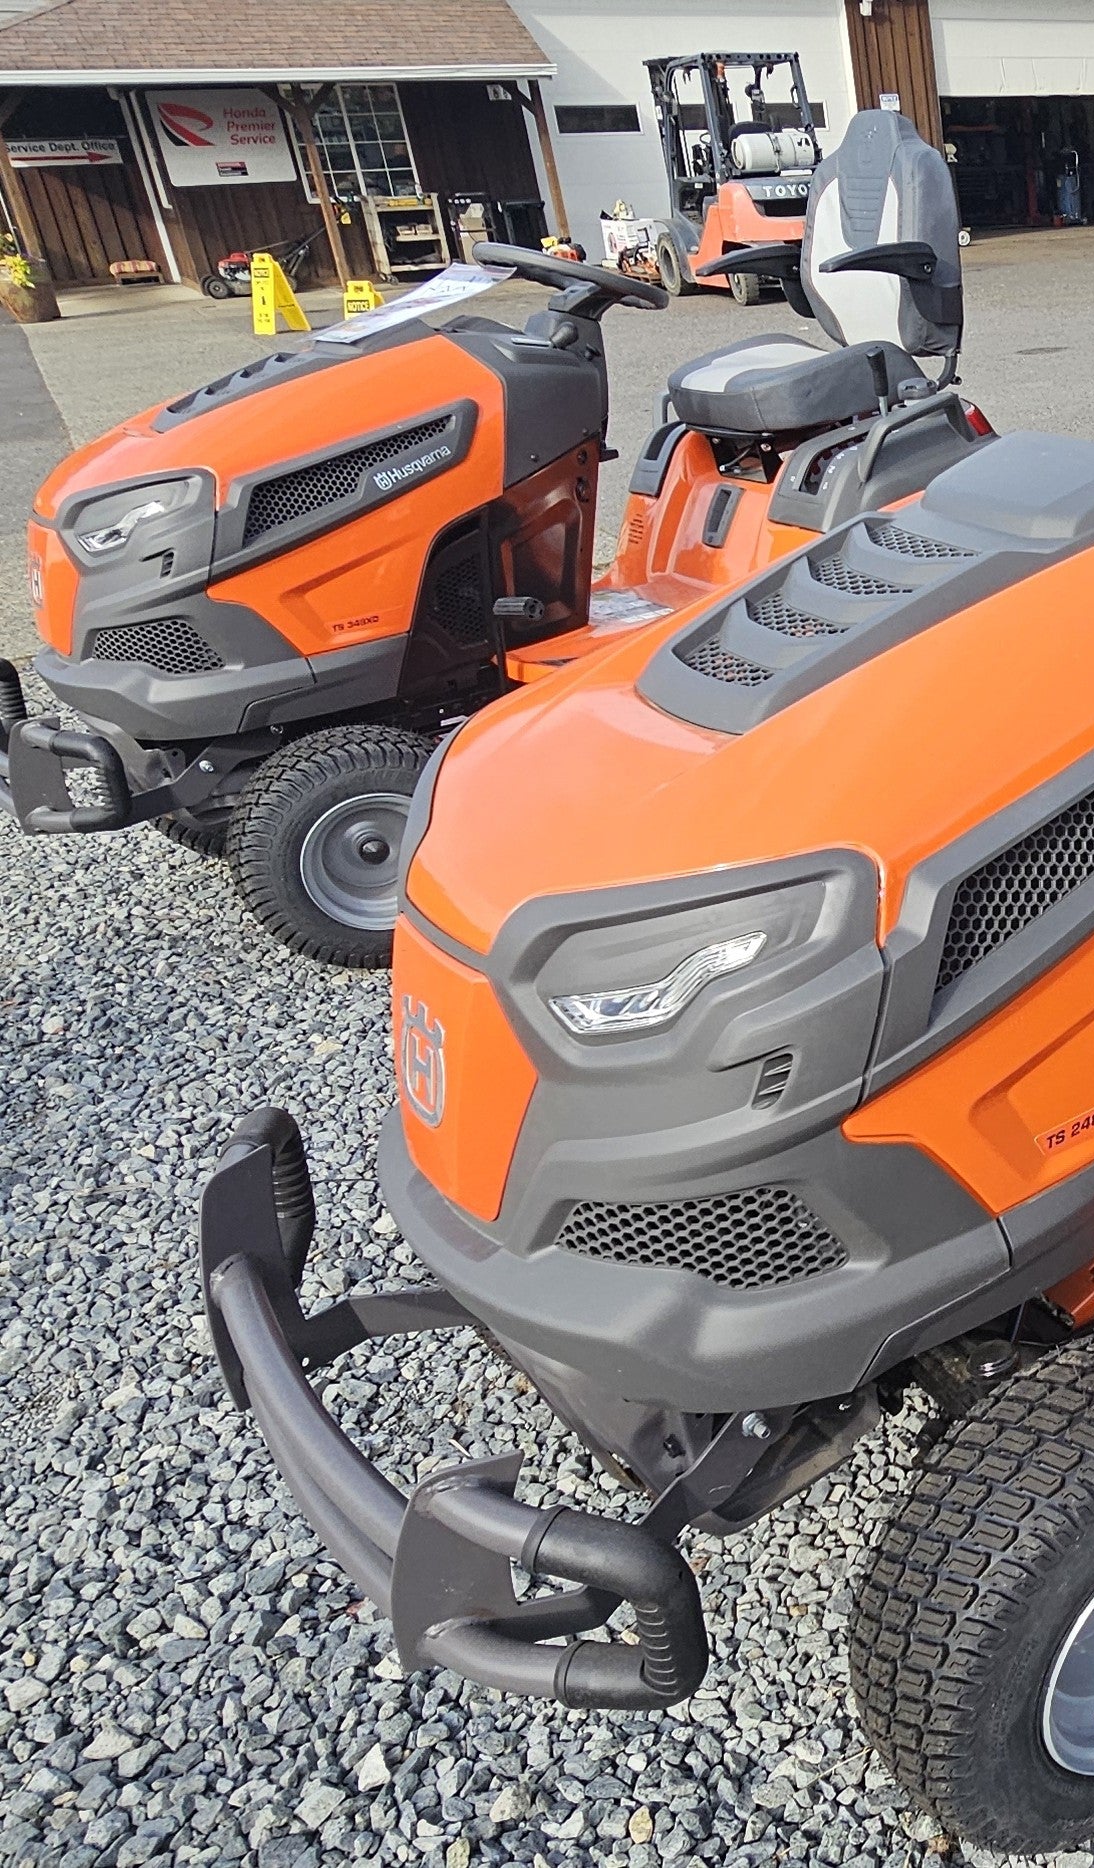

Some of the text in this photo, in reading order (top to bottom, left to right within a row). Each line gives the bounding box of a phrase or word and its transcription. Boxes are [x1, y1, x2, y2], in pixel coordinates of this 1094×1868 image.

[223, 106, 266, 119] Honda
[227, 120, 276, 132] Premier
[230, 133, 276, 146] Service
[48, 142, 79, 153] Dept.
[82, 140, 115, 151] Office
[762, 183, 811, 198] TOYO
[347, 300, 370, 313] NOTICE
[387, 445, 451, 483] Husqvarna
[1046, 1129, 1066, 1149] TS
